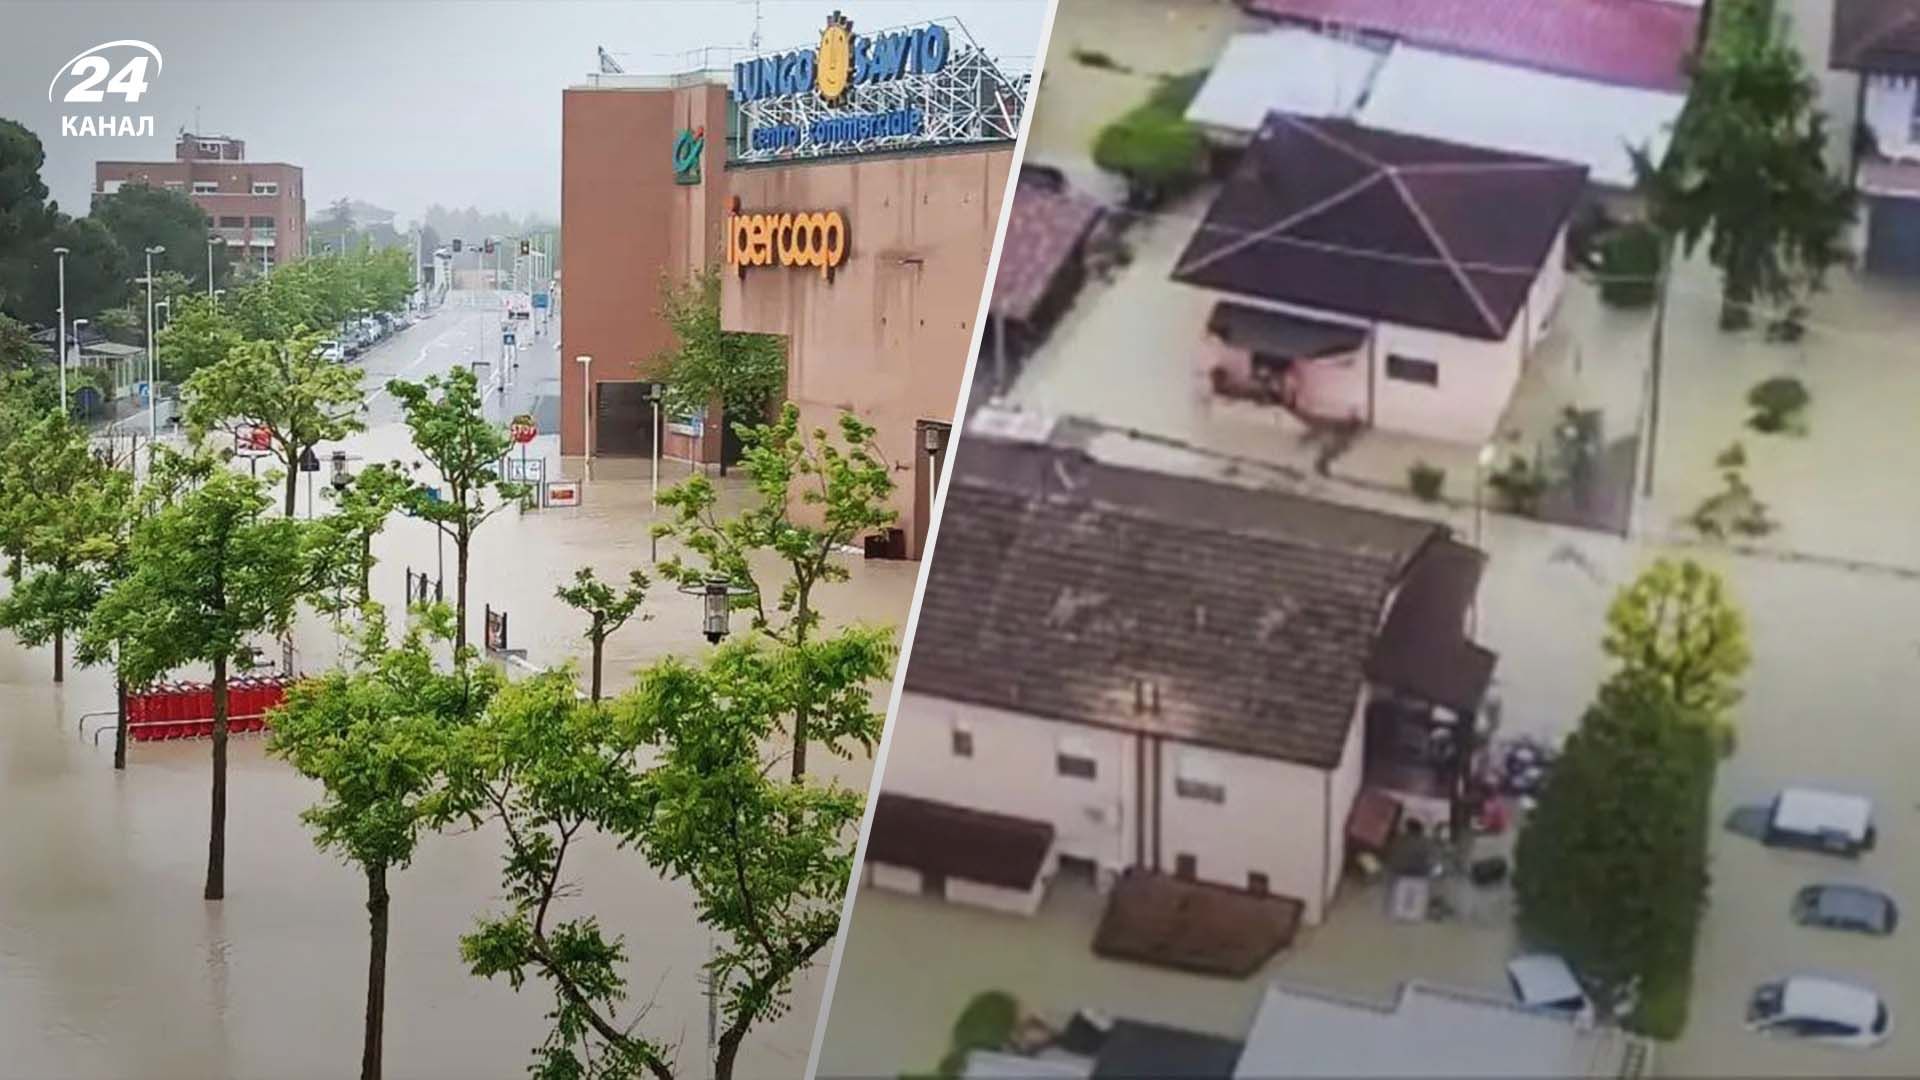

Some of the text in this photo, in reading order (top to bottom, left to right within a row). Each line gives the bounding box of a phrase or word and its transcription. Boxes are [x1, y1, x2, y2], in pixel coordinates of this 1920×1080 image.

[734, 23, 949, 101] LUNGO SAVIO
[724, 195, 846, 281] ipercoop
